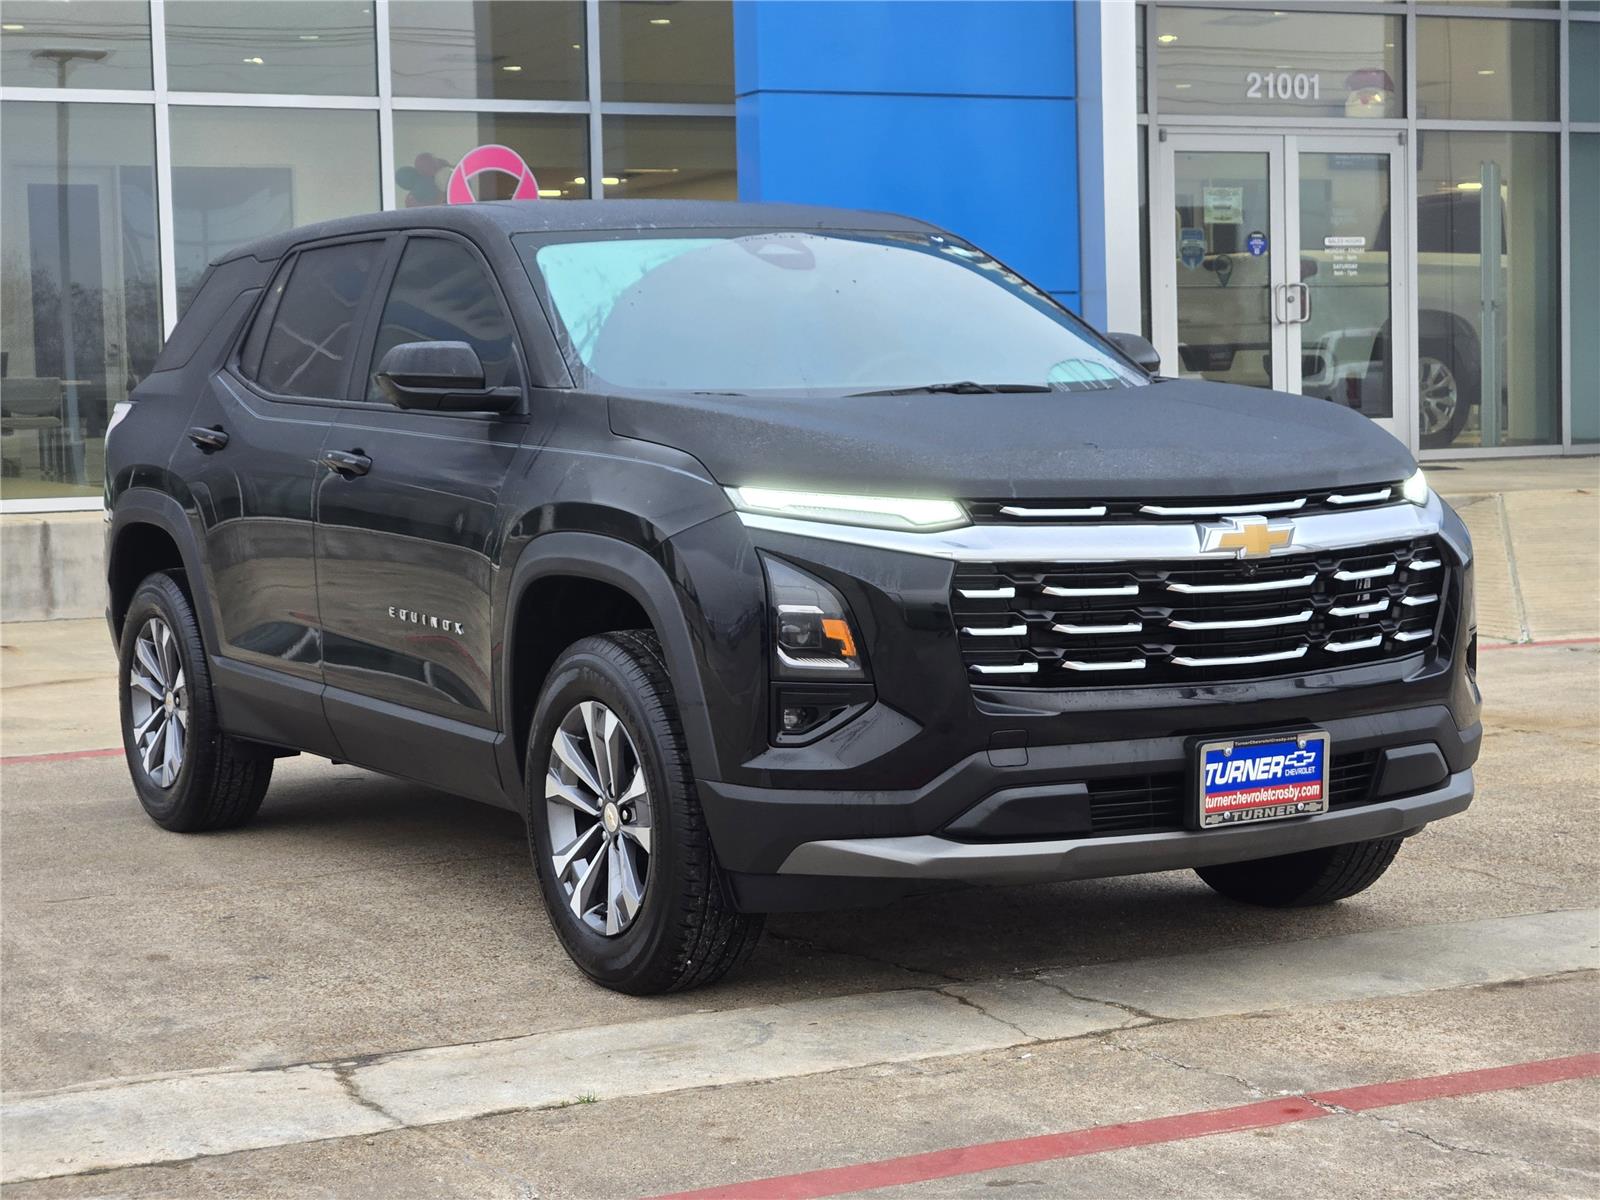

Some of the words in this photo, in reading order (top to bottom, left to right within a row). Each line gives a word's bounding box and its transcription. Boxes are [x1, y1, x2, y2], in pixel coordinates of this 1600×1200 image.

[1246, 72, 1320, 100] 21001
[388, 606, 464, 635] EQUINOX
[1205, 755, 1284, 787] TURNER
[1284, 766, 1316, 777] CHEVROLET
[1205, 784, 1320, 808] turnerchevroletcrosby.com
[1232, 805, 1296, 821] TURNER
